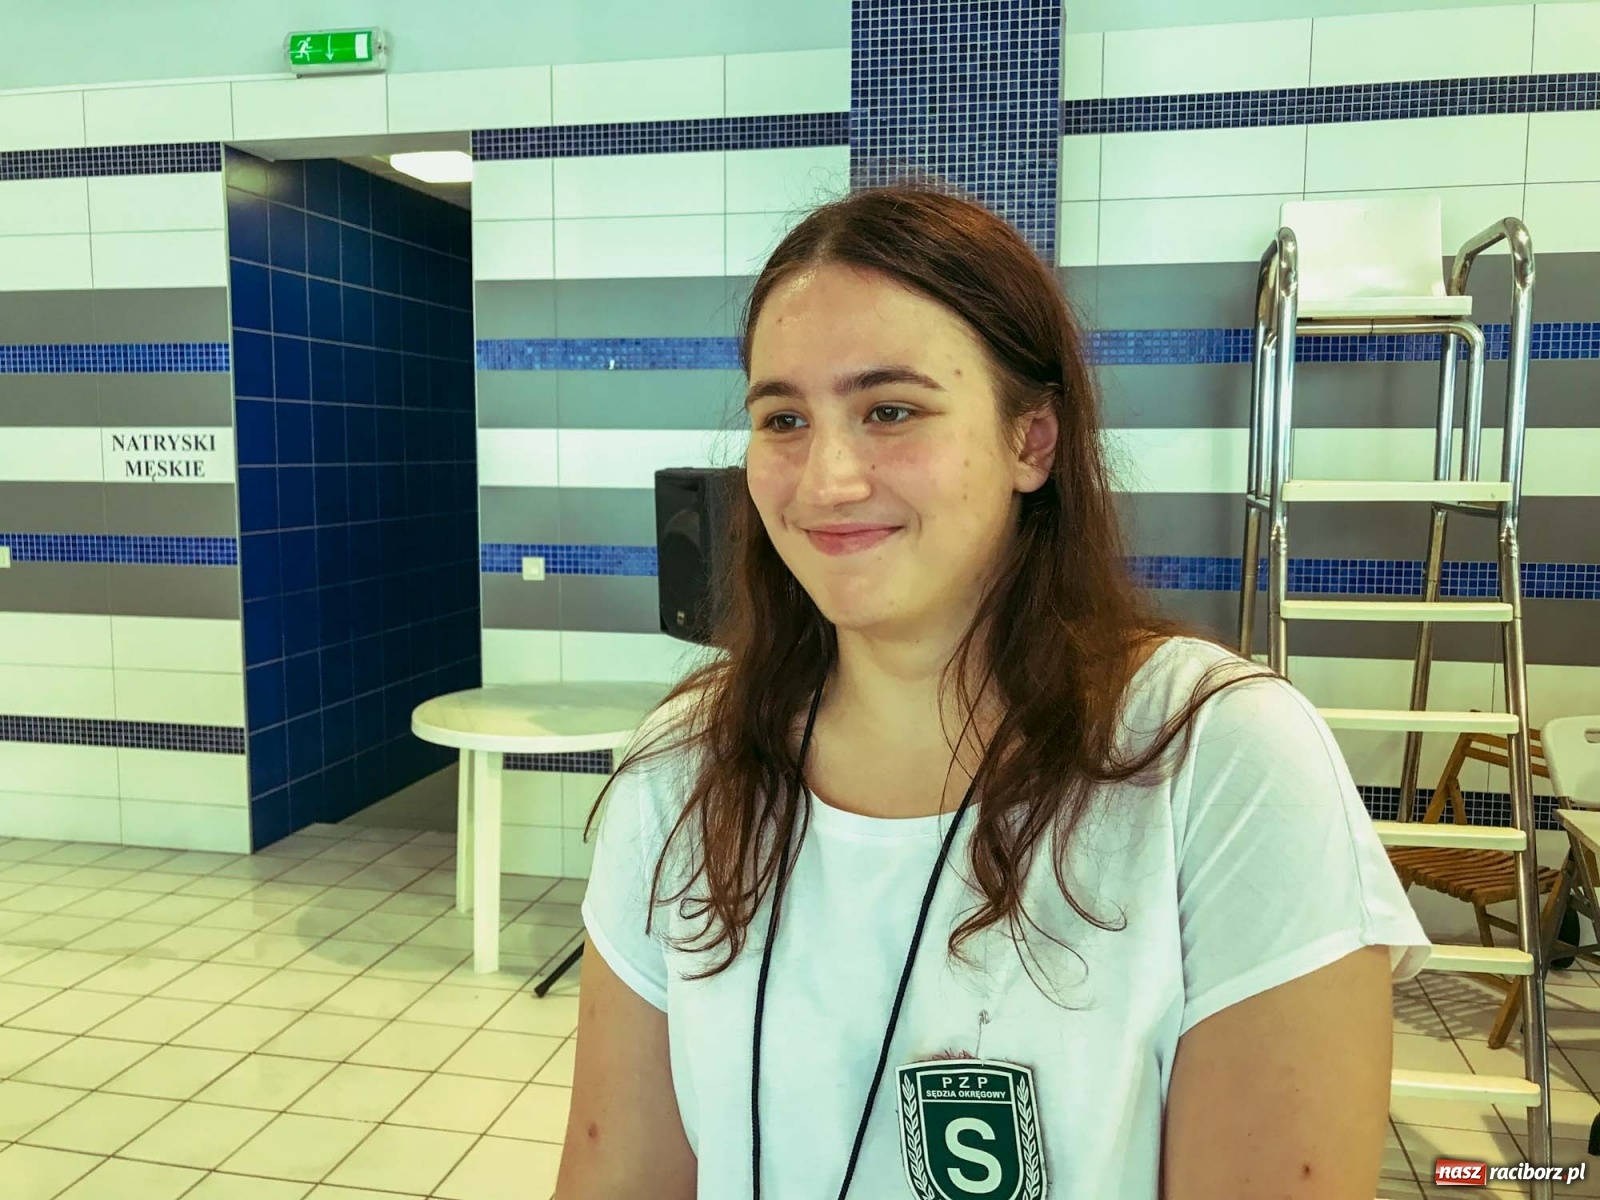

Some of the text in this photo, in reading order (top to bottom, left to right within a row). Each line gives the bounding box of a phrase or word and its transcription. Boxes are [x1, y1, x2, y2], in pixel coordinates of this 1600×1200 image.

[112, 434, 216, 452] NATRYSKI
[125, 460, 205, 482] MĘSKIE
[926, 1090, 1006, 1099] SĘDZIA OKRĘGOWY
[945, 1117, 1002, 1194] S
